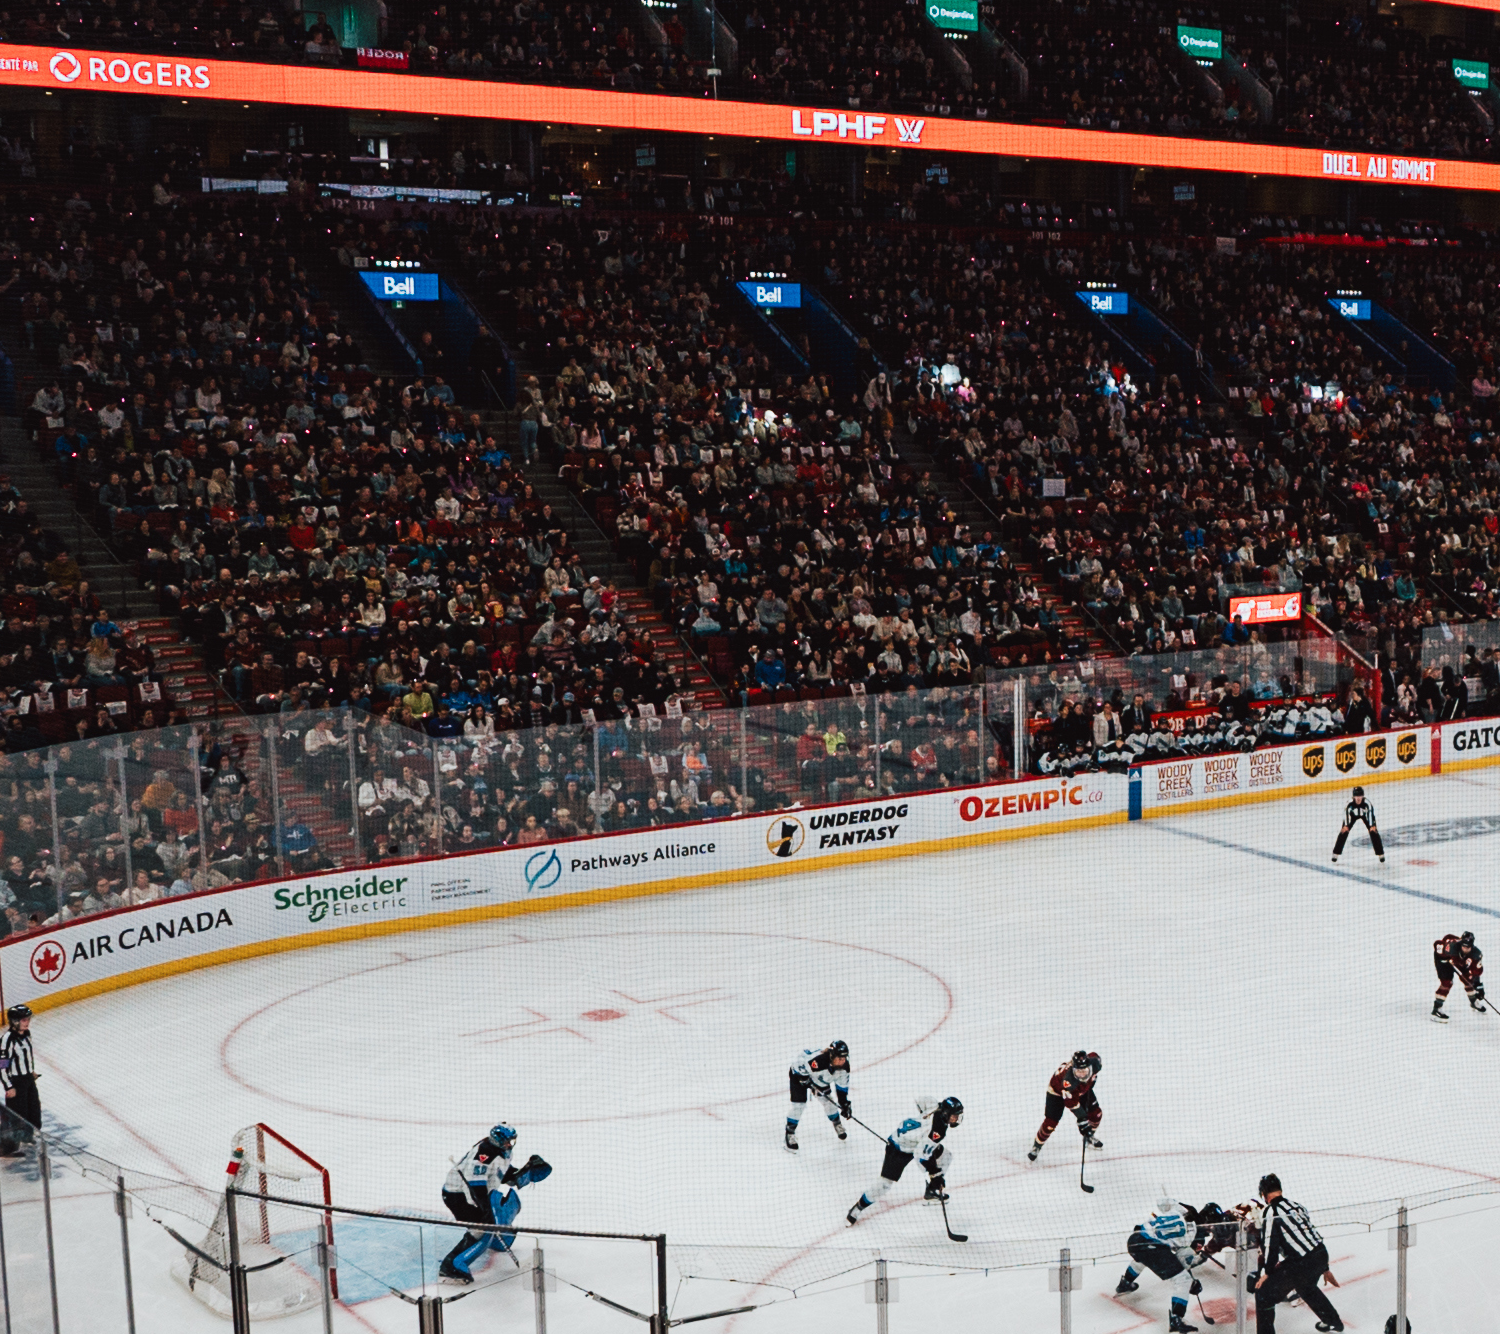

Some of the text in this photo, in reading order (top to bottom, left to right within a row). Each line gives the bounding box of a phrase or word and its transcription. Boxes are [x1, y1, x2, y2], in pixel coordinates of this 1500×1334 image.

[89, 57, 210, 89] ROGERS
[792, 110, 887, 140] LPHF
[1322, 152, 1436, 182] DUEL AU SOMMET
[384, 276, 415, 295] Bell
[756, 286, 782, 303] Bell
[1248, 752, 1283, 767] WOODY
[1336, 749, 1355, 769] ups
[1366, 745, 1386, 765] ups
[1397, 740, 1416, 760] ups
[1157, 764, 1193, 780] WOODY
[1204, 758, 1239, 774] WOODY
[1249, 763, 1282, 779] CREEK
[1303, 753, 1323, 773] ups
[1158, 776, 1192, 793] CREEK
[1203, 781, 1240, 794] DISTILLERS
[1205, 770, 1238, 786] CREEK
[1248, 774, 1284, 788] DISTILLERS
[1156, 788, 1194, 801] DISTILLERS
[809, 803, 909, 832] UNDERDOG
[818, 824, 901, 850] FANTASY
[571, 840, 716, 873] Pathways Alliance
[273, 875, 409, 913] Schneider
[332, 895, 408, 918] Electric
[71, 908, 234, 965] AIR CANADA
